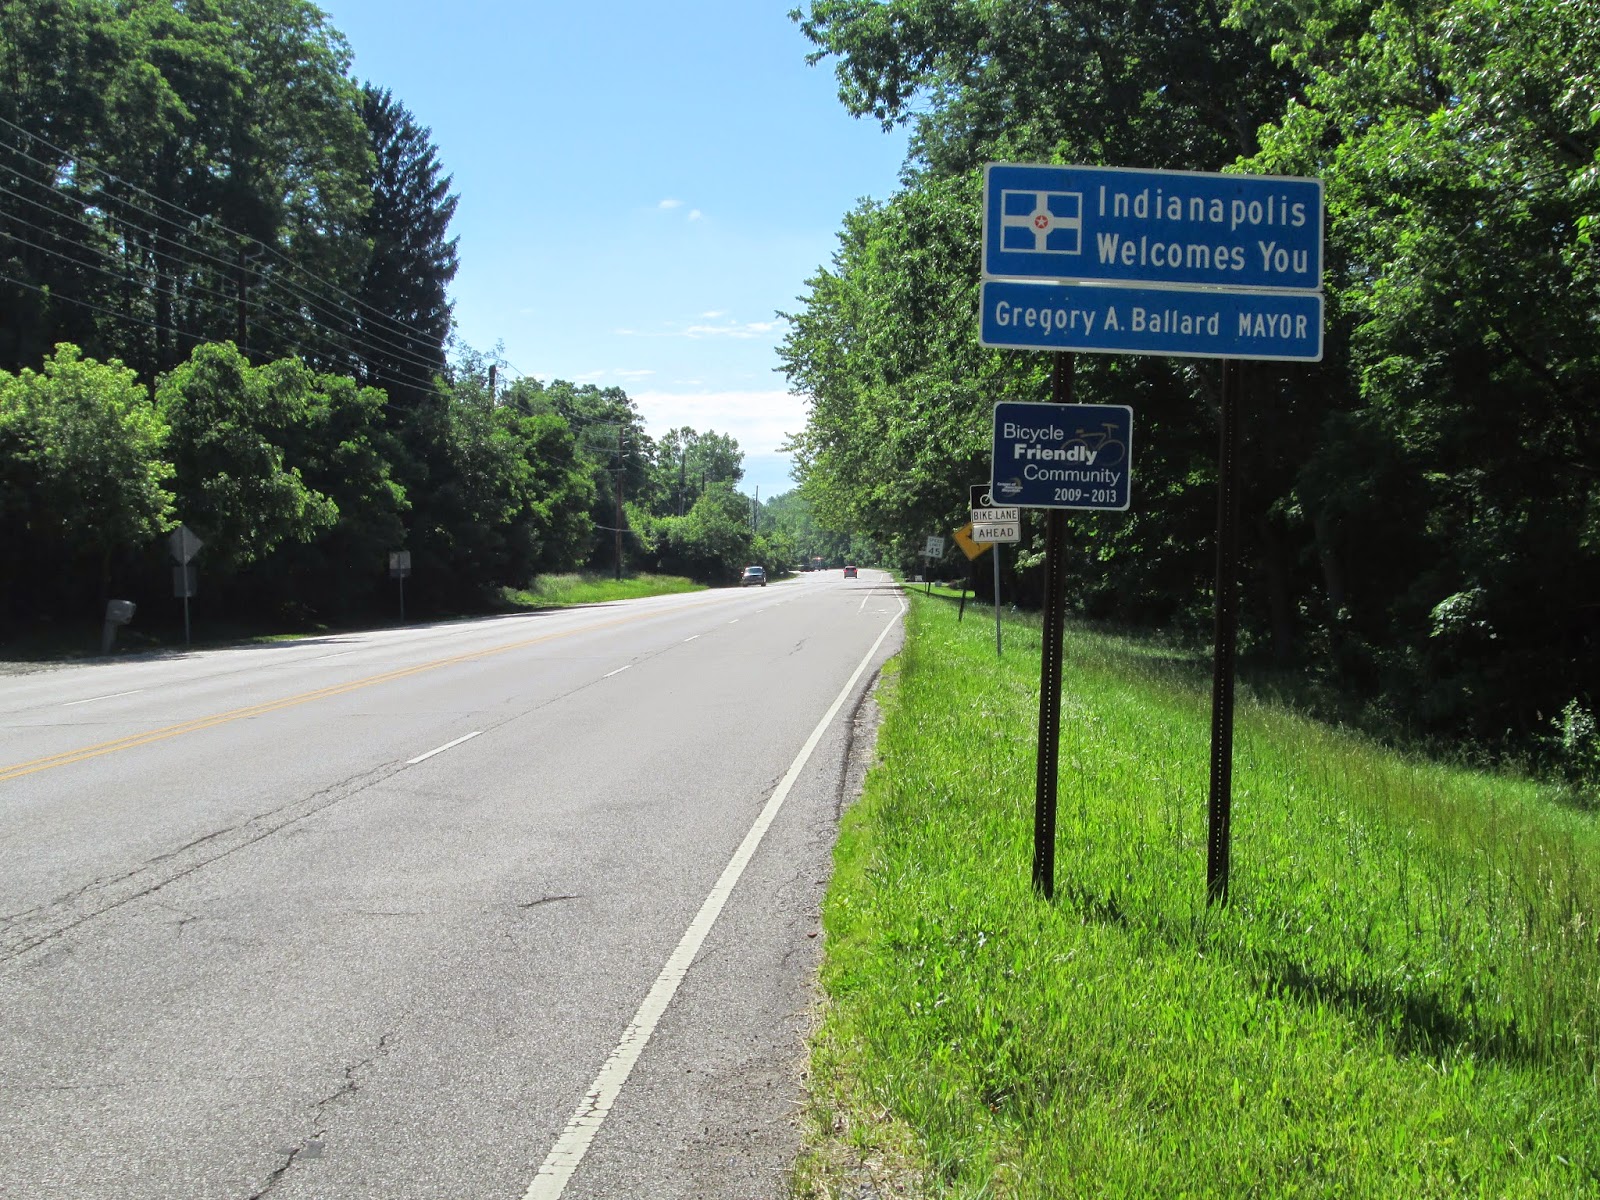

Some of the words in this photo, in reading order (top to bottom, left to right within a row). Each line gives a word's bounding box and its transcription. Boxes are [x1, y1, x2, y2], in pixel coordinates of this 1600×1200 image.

[1099, 185, 1306, 231] Indianapolis
[1097, 232, 1245, 270] Welcomes
[1258, 241, 1308, 273] You
[995, 300, 1096, 336] Gregory
[1104, 306, 1125, 332] A.
[1131, 307, 1219, 336] Ballard
[1238, 312, 1307, 339] MAYOR
[1003, 422, 1064, 444] Bicycle
[1014, 443, 1097, 465] Friendly
[1024, 464, 1121, 487] Community
[973, 510, 993, 520] BIKE
[995, 509, 1017, 520] LANE
[978, 527, 1014, 538] AHEAD
[928, 547, 940, 556] 45
